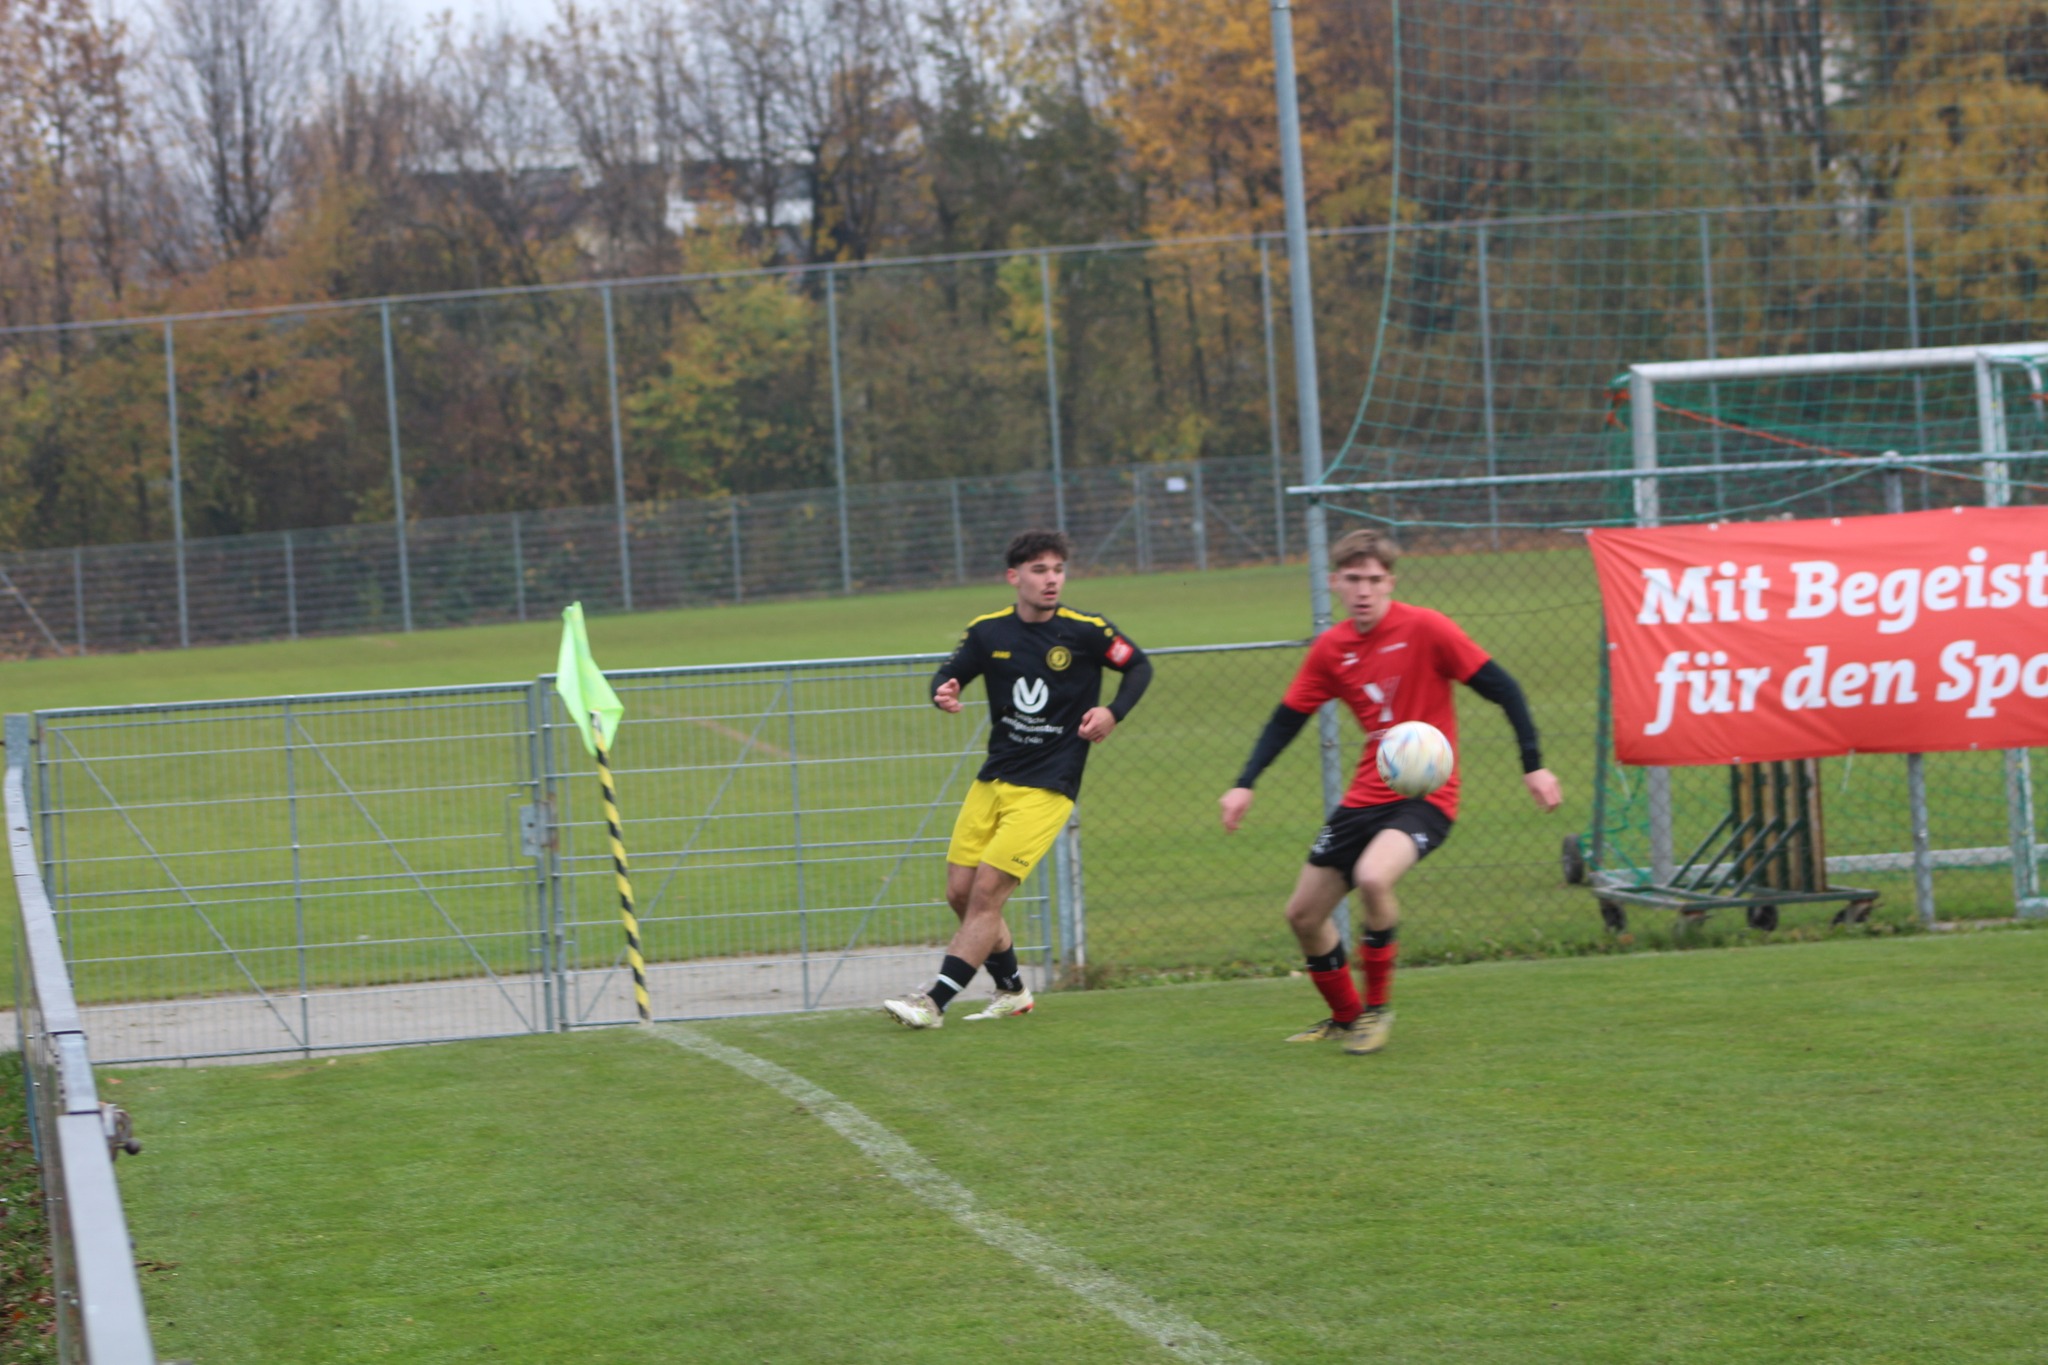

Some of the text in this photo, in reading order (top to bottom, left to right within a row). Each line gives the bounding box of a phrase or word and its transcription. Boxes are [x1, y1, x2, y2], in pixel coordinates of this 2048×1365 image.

[1636, 546, 2048, 634] Mit Begeist
[1643, 639, 2048, 736] für den Spo
